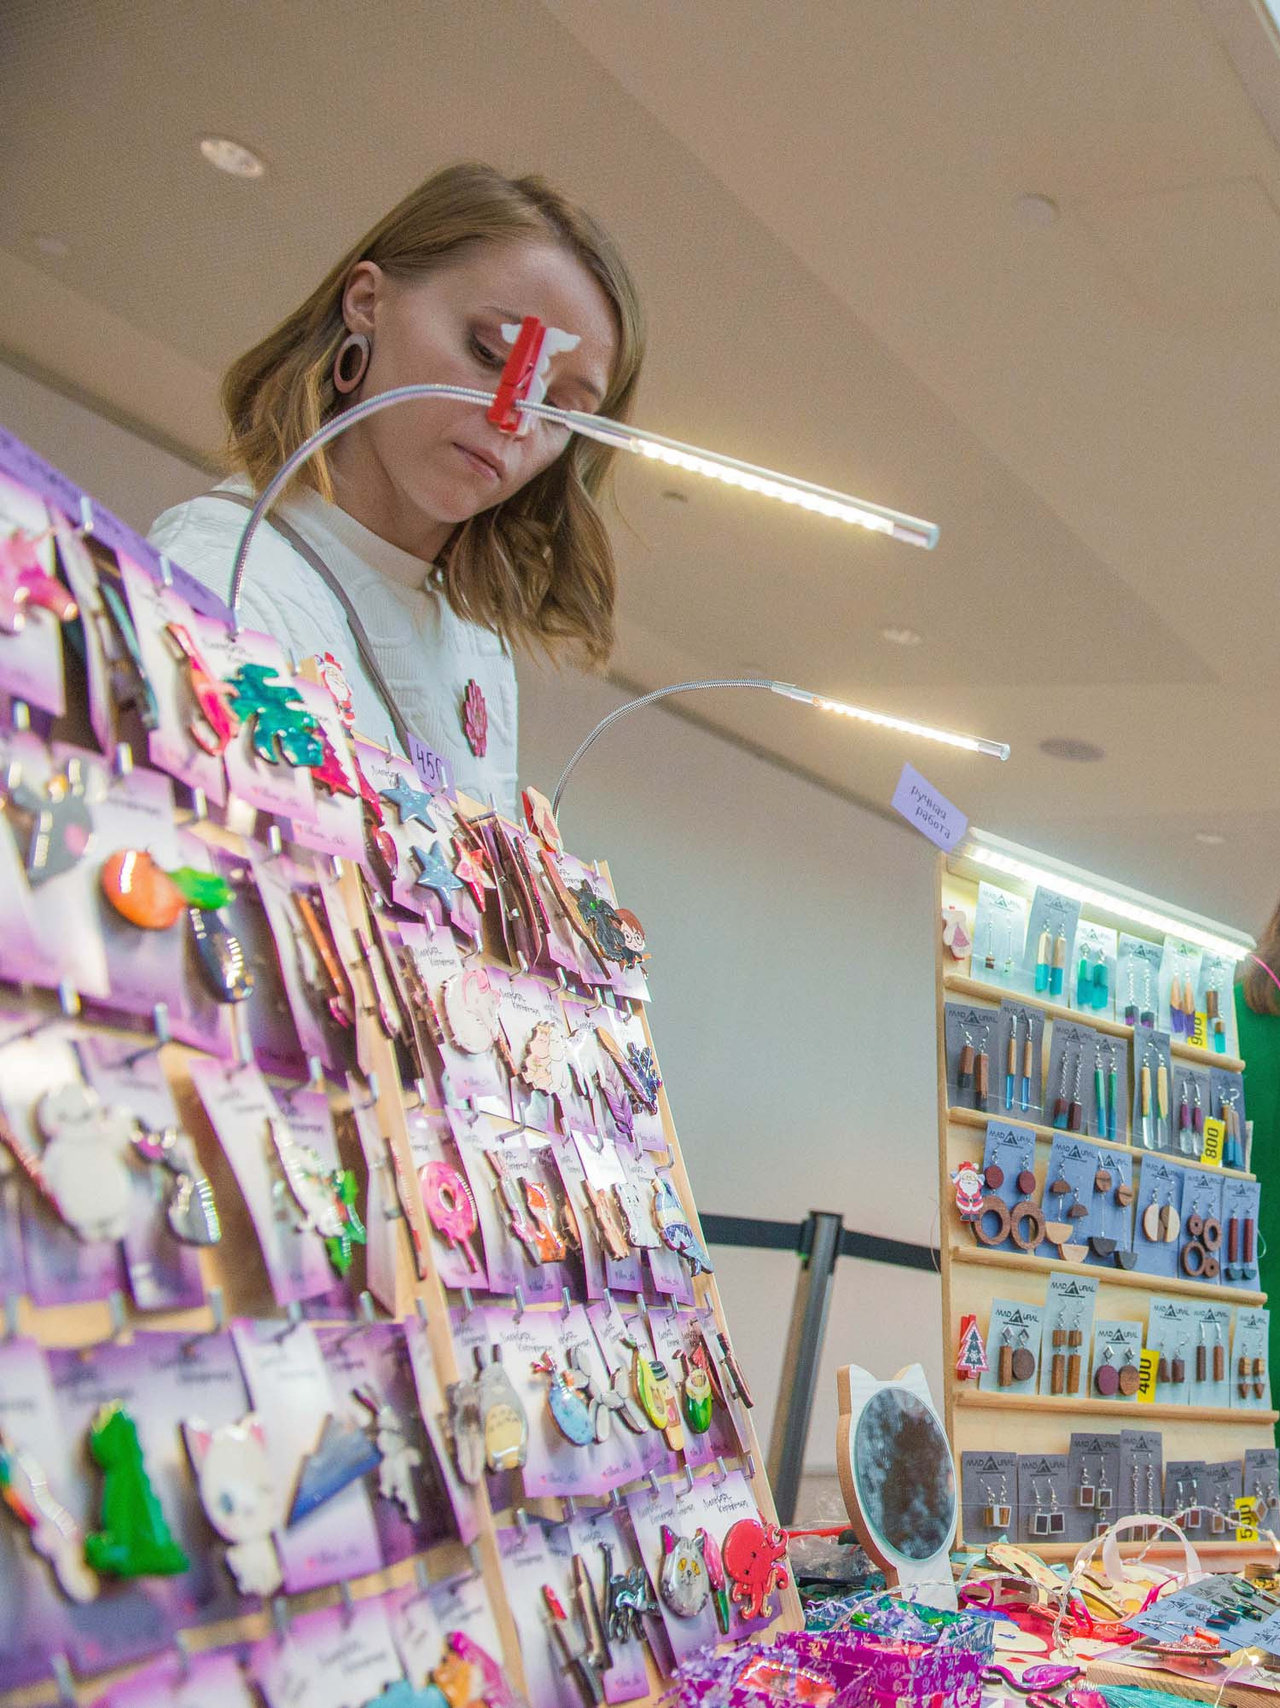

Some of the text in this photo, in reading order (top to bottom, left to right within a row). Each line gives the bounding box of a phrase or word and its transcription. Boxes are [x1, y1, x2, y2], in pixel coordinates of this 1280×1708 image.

[910, 784, 947, 821] ручная
[915, 805, 951, 839] работа
[1191, 1017, 1203, 1046] 900
[1205, 1127, 1219, 1159] 800
[1138, 1358, 1152, 1394] 400
